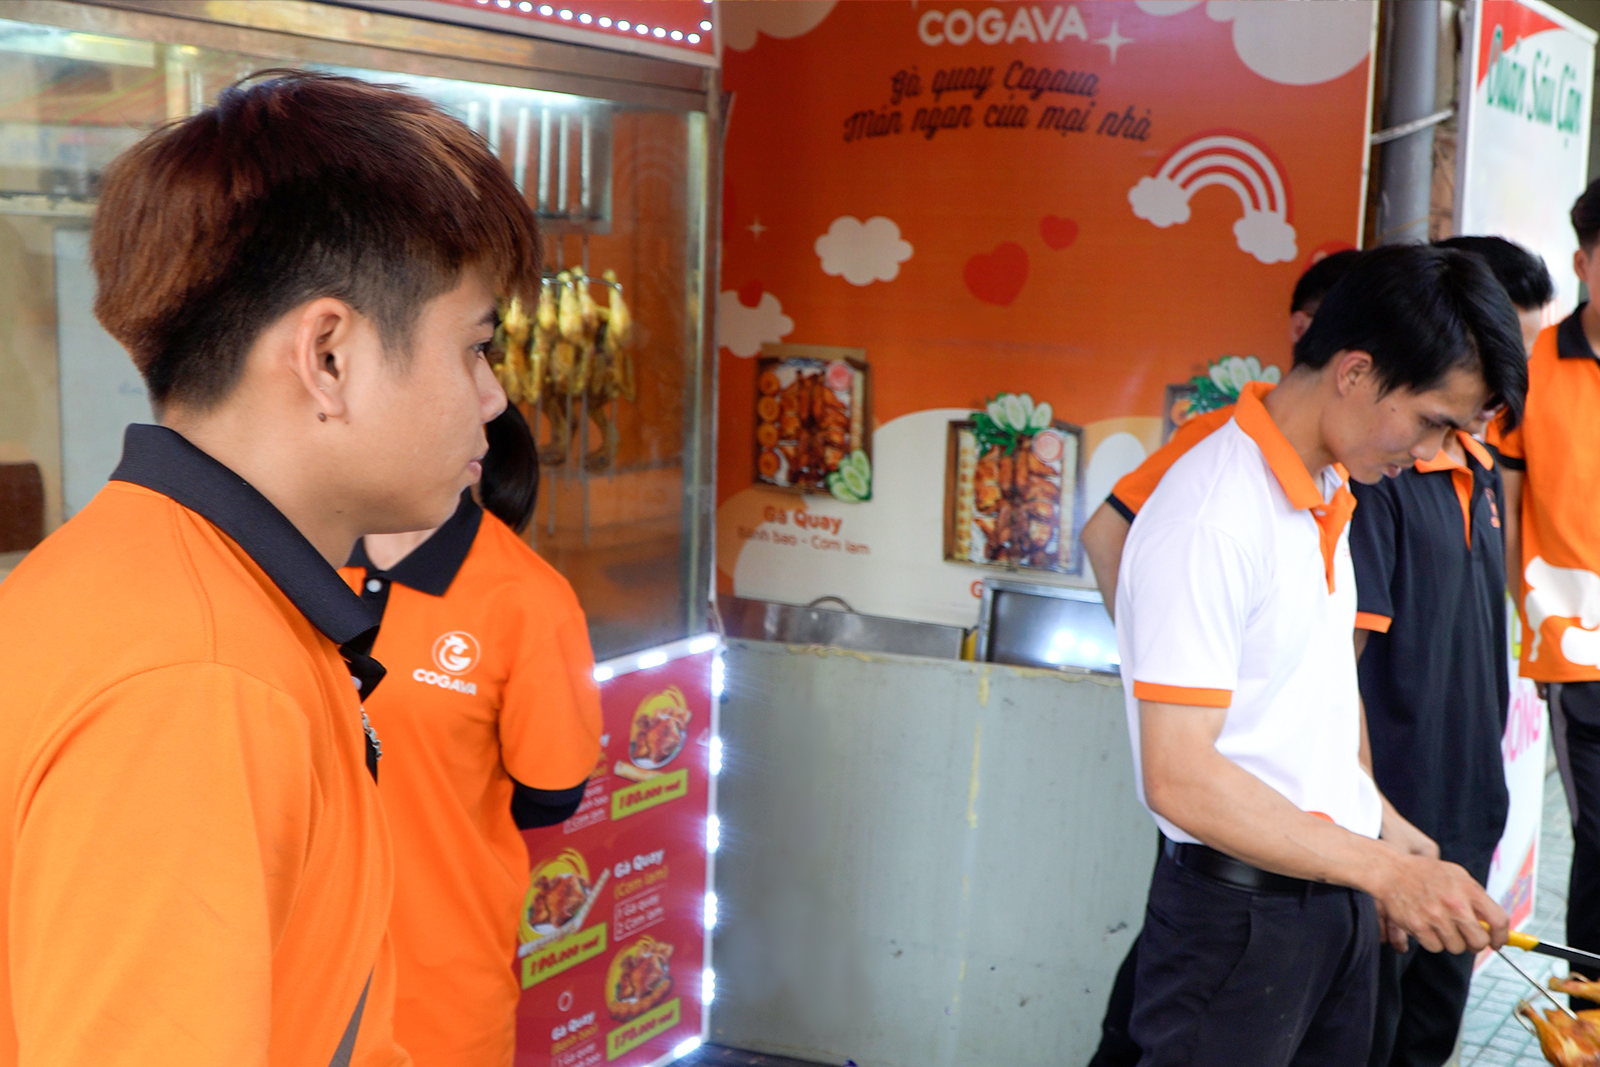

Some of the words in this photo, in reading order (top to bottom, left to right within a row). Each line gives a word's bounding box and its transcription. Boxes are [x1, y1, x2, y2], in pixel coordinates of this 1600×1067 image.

[917, 5, 1088, 46] COGAVA
[793, 508, 842, 536] Quay
[412, 668, 477, 697] COGAVA
